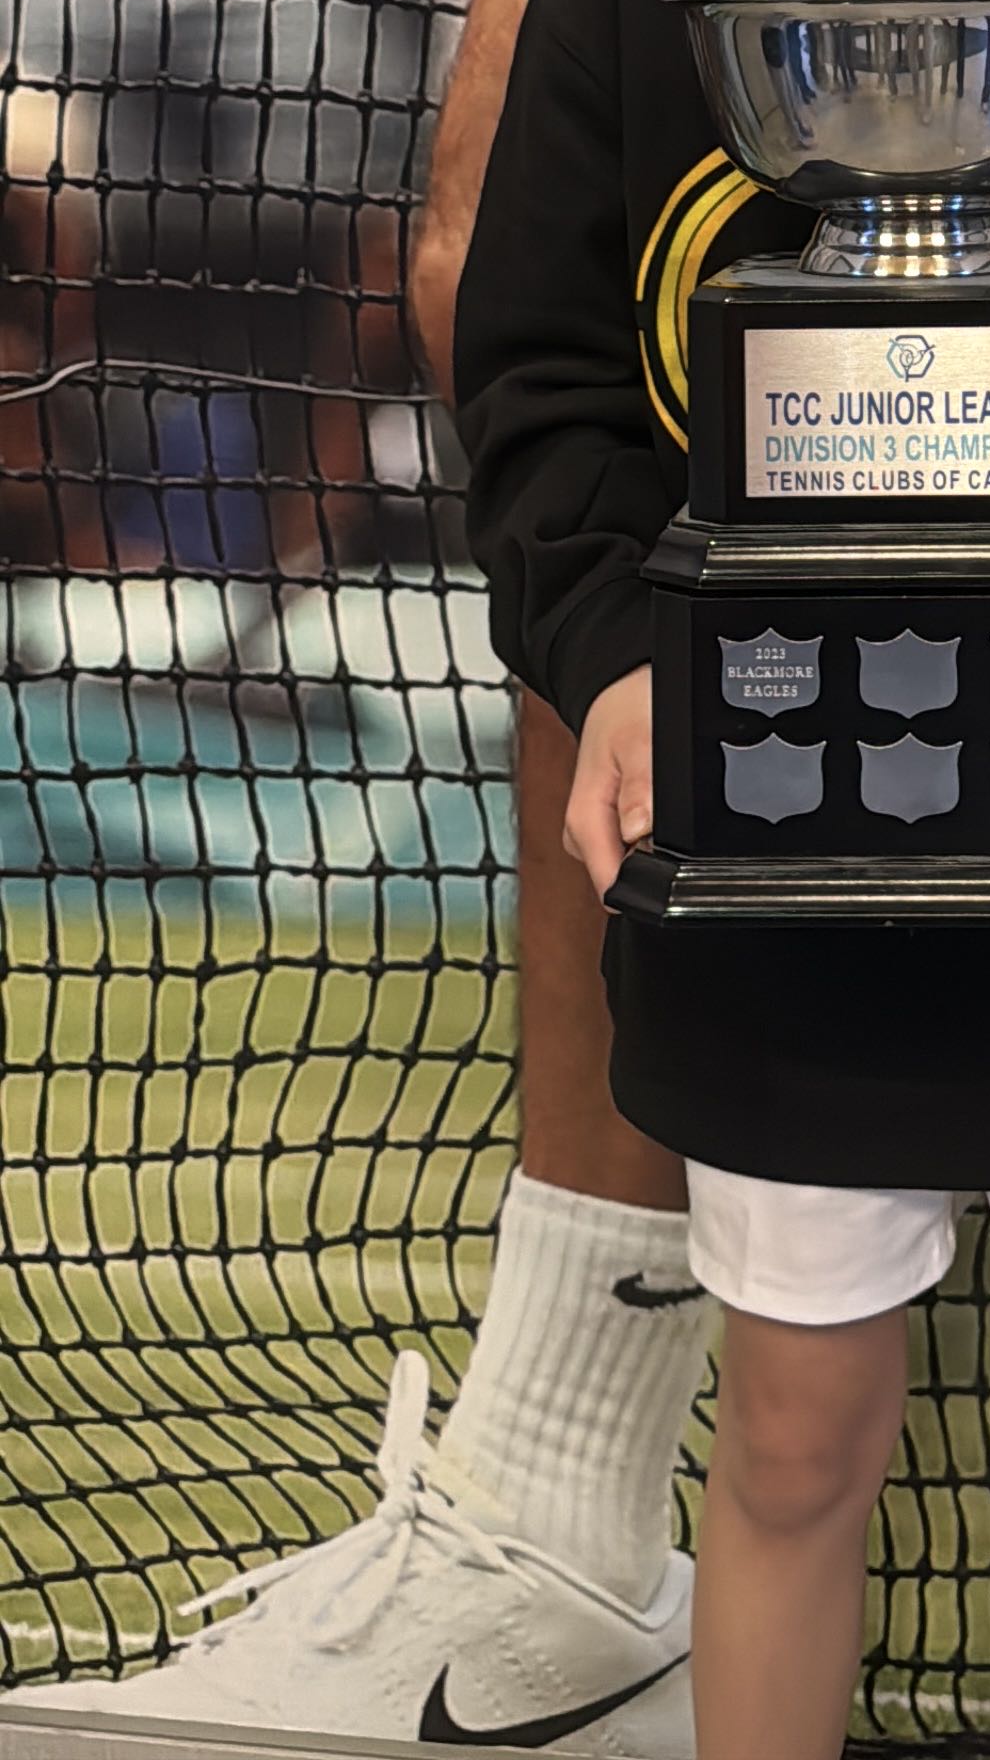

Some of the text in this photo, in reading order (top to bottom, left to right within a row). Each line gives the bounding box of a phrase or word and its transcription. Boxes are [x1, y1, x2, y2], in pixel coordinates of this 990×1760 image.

[765, 391, 821, 426] TCC
[830, 391, 936, 425] JUNIOR
[765, 435, 876, 462] DIVISION
[884, 435, 897, 461] 3
[766, 471, 846, 492] TENNIS
[852, 470, 925, 491] CLUBS
[932, 470, 960, 490] OF
[755, 647, 786, 660] 2023
[727, 666, 814, 679] BLACKMORE
[743, 685, 799, 698] EAGLES
